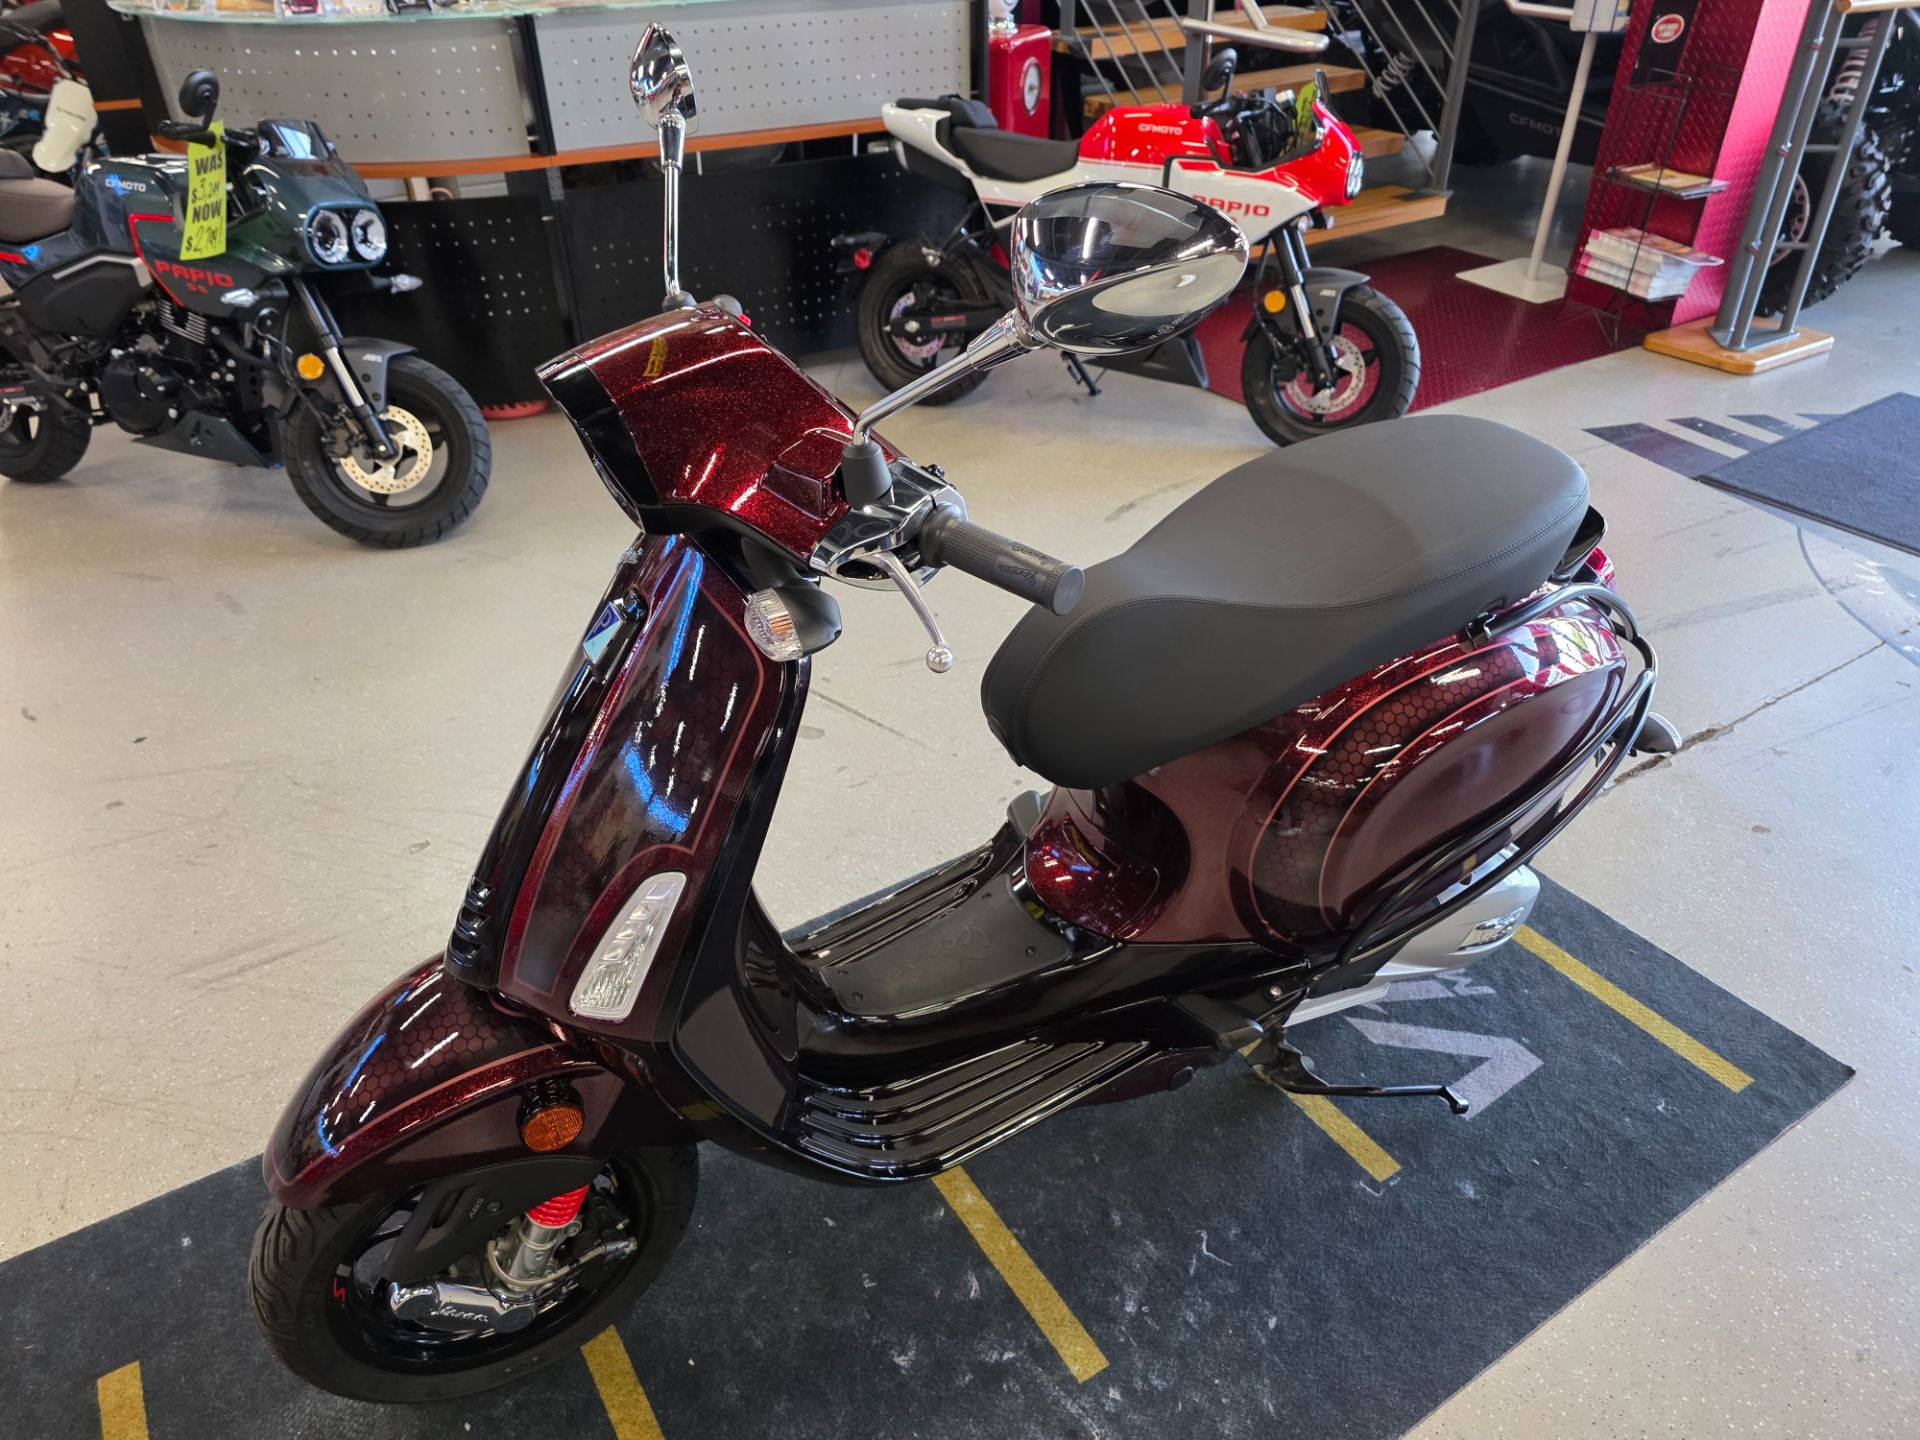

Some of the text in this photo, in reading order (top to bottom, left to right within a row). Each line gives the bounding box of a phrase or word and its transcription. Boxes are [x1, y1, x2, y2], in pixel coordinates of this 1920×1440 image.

[1138, 123, 1183, 135] CFMOTO
[194, 152, 223, 176] WAS
[192, 198, 223, 224] NOW
